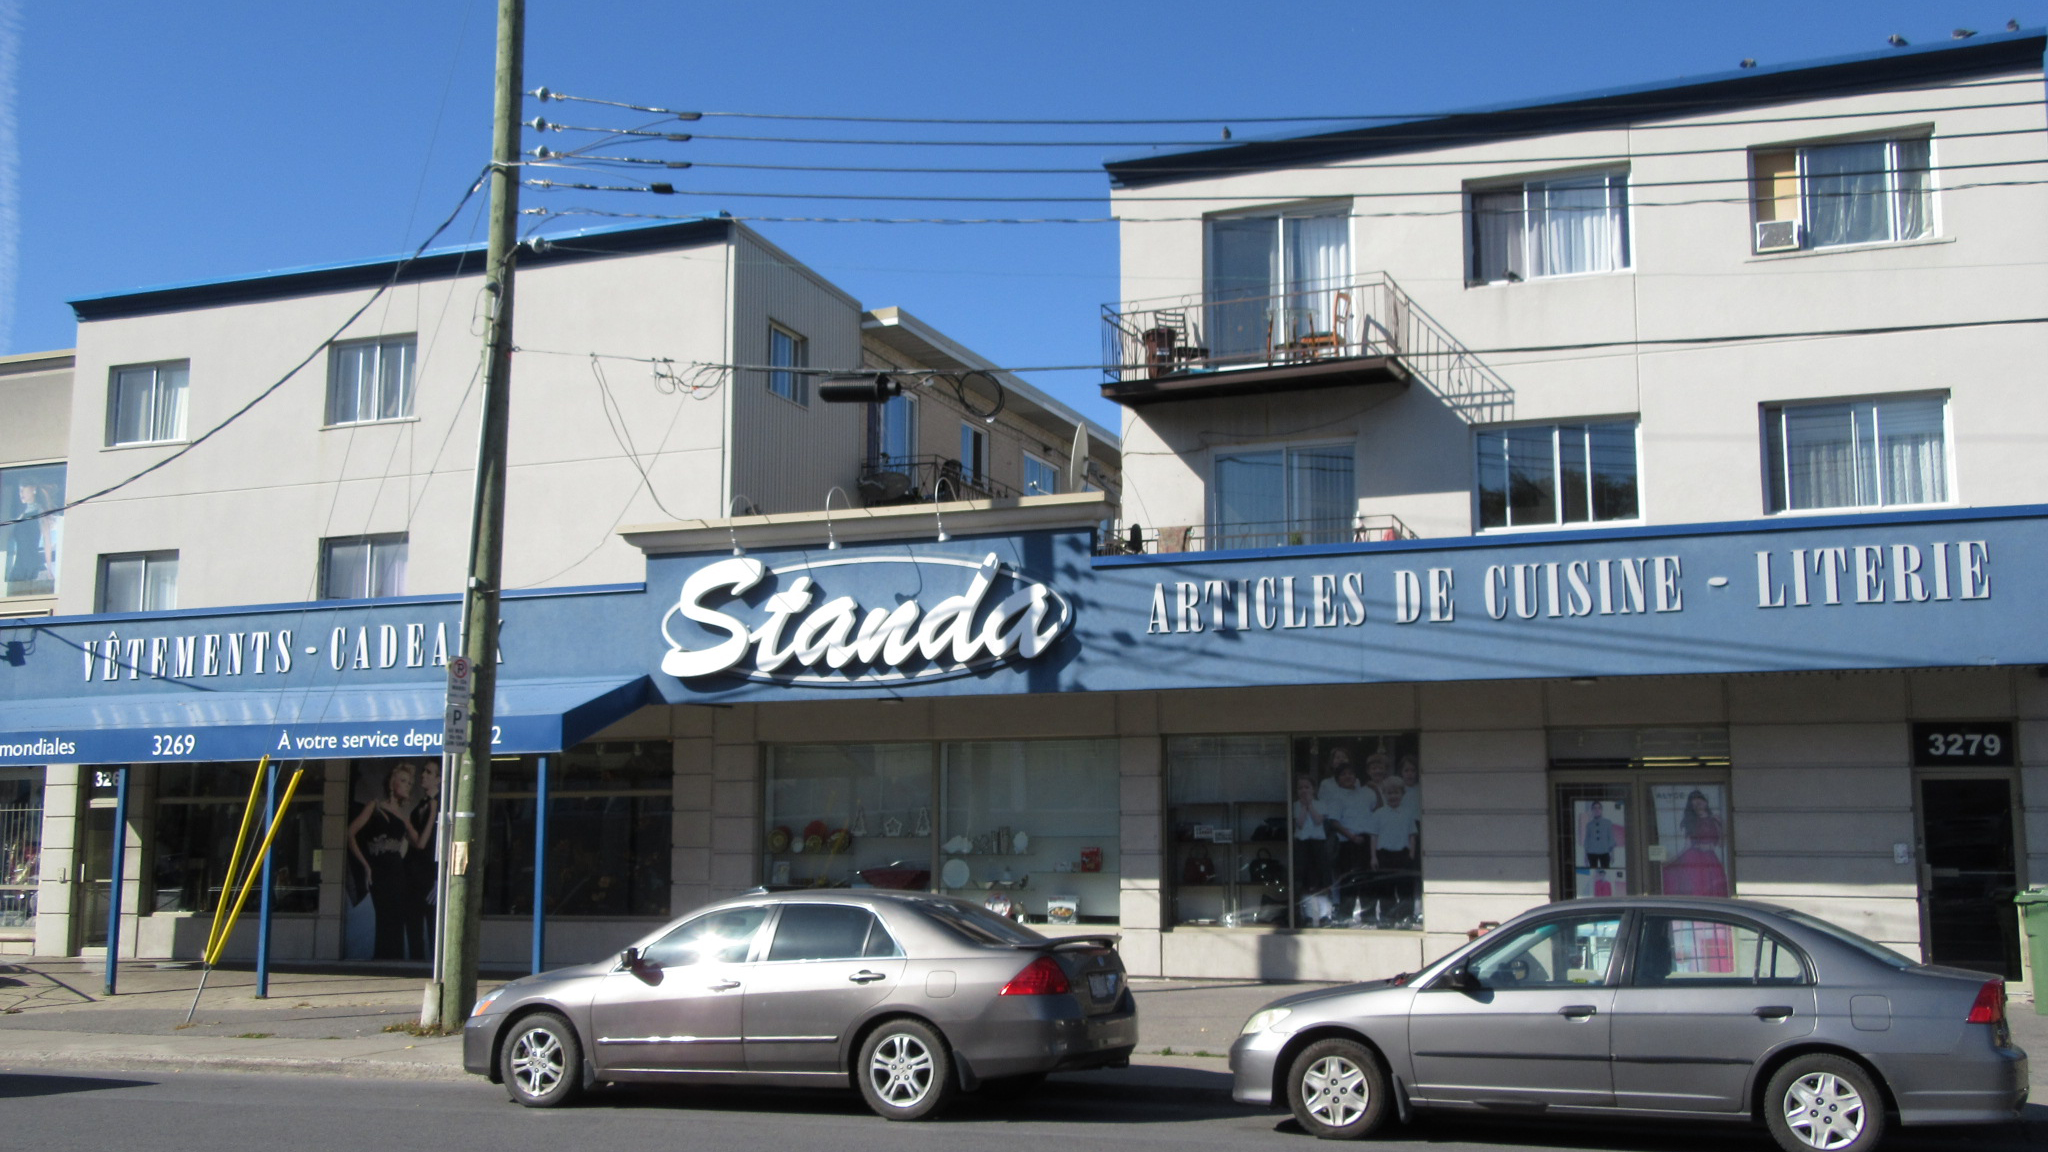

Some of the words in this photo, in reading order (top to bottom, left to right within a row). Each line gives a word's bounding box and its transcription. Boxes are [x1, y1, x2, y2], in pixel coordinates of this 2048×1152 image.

[1147, 571, 1367, 634] ARTICLES
[1394, 567, 1455, 624] DE
[1484, 555, 1683, 619] CUISINE
[1754, 540, 1992, 608] LITERIE
[661, 552, 1062, 678] Standa
[83, 630, 293, 682] VÊTEMENTS
[331, 619, 504, 671] CADEA
[0, 737, 76, 757] mondiales
[151, 734, 196, 756] 3269
[277, 730, 291, 750] À
[296, 735, 337, 749] votre
[342, 730, 399, 748] service
[403, 728, 443, 751] depu
[1928, 733, 2001, 756] 3279
[95, 771, 120, 787] 326
